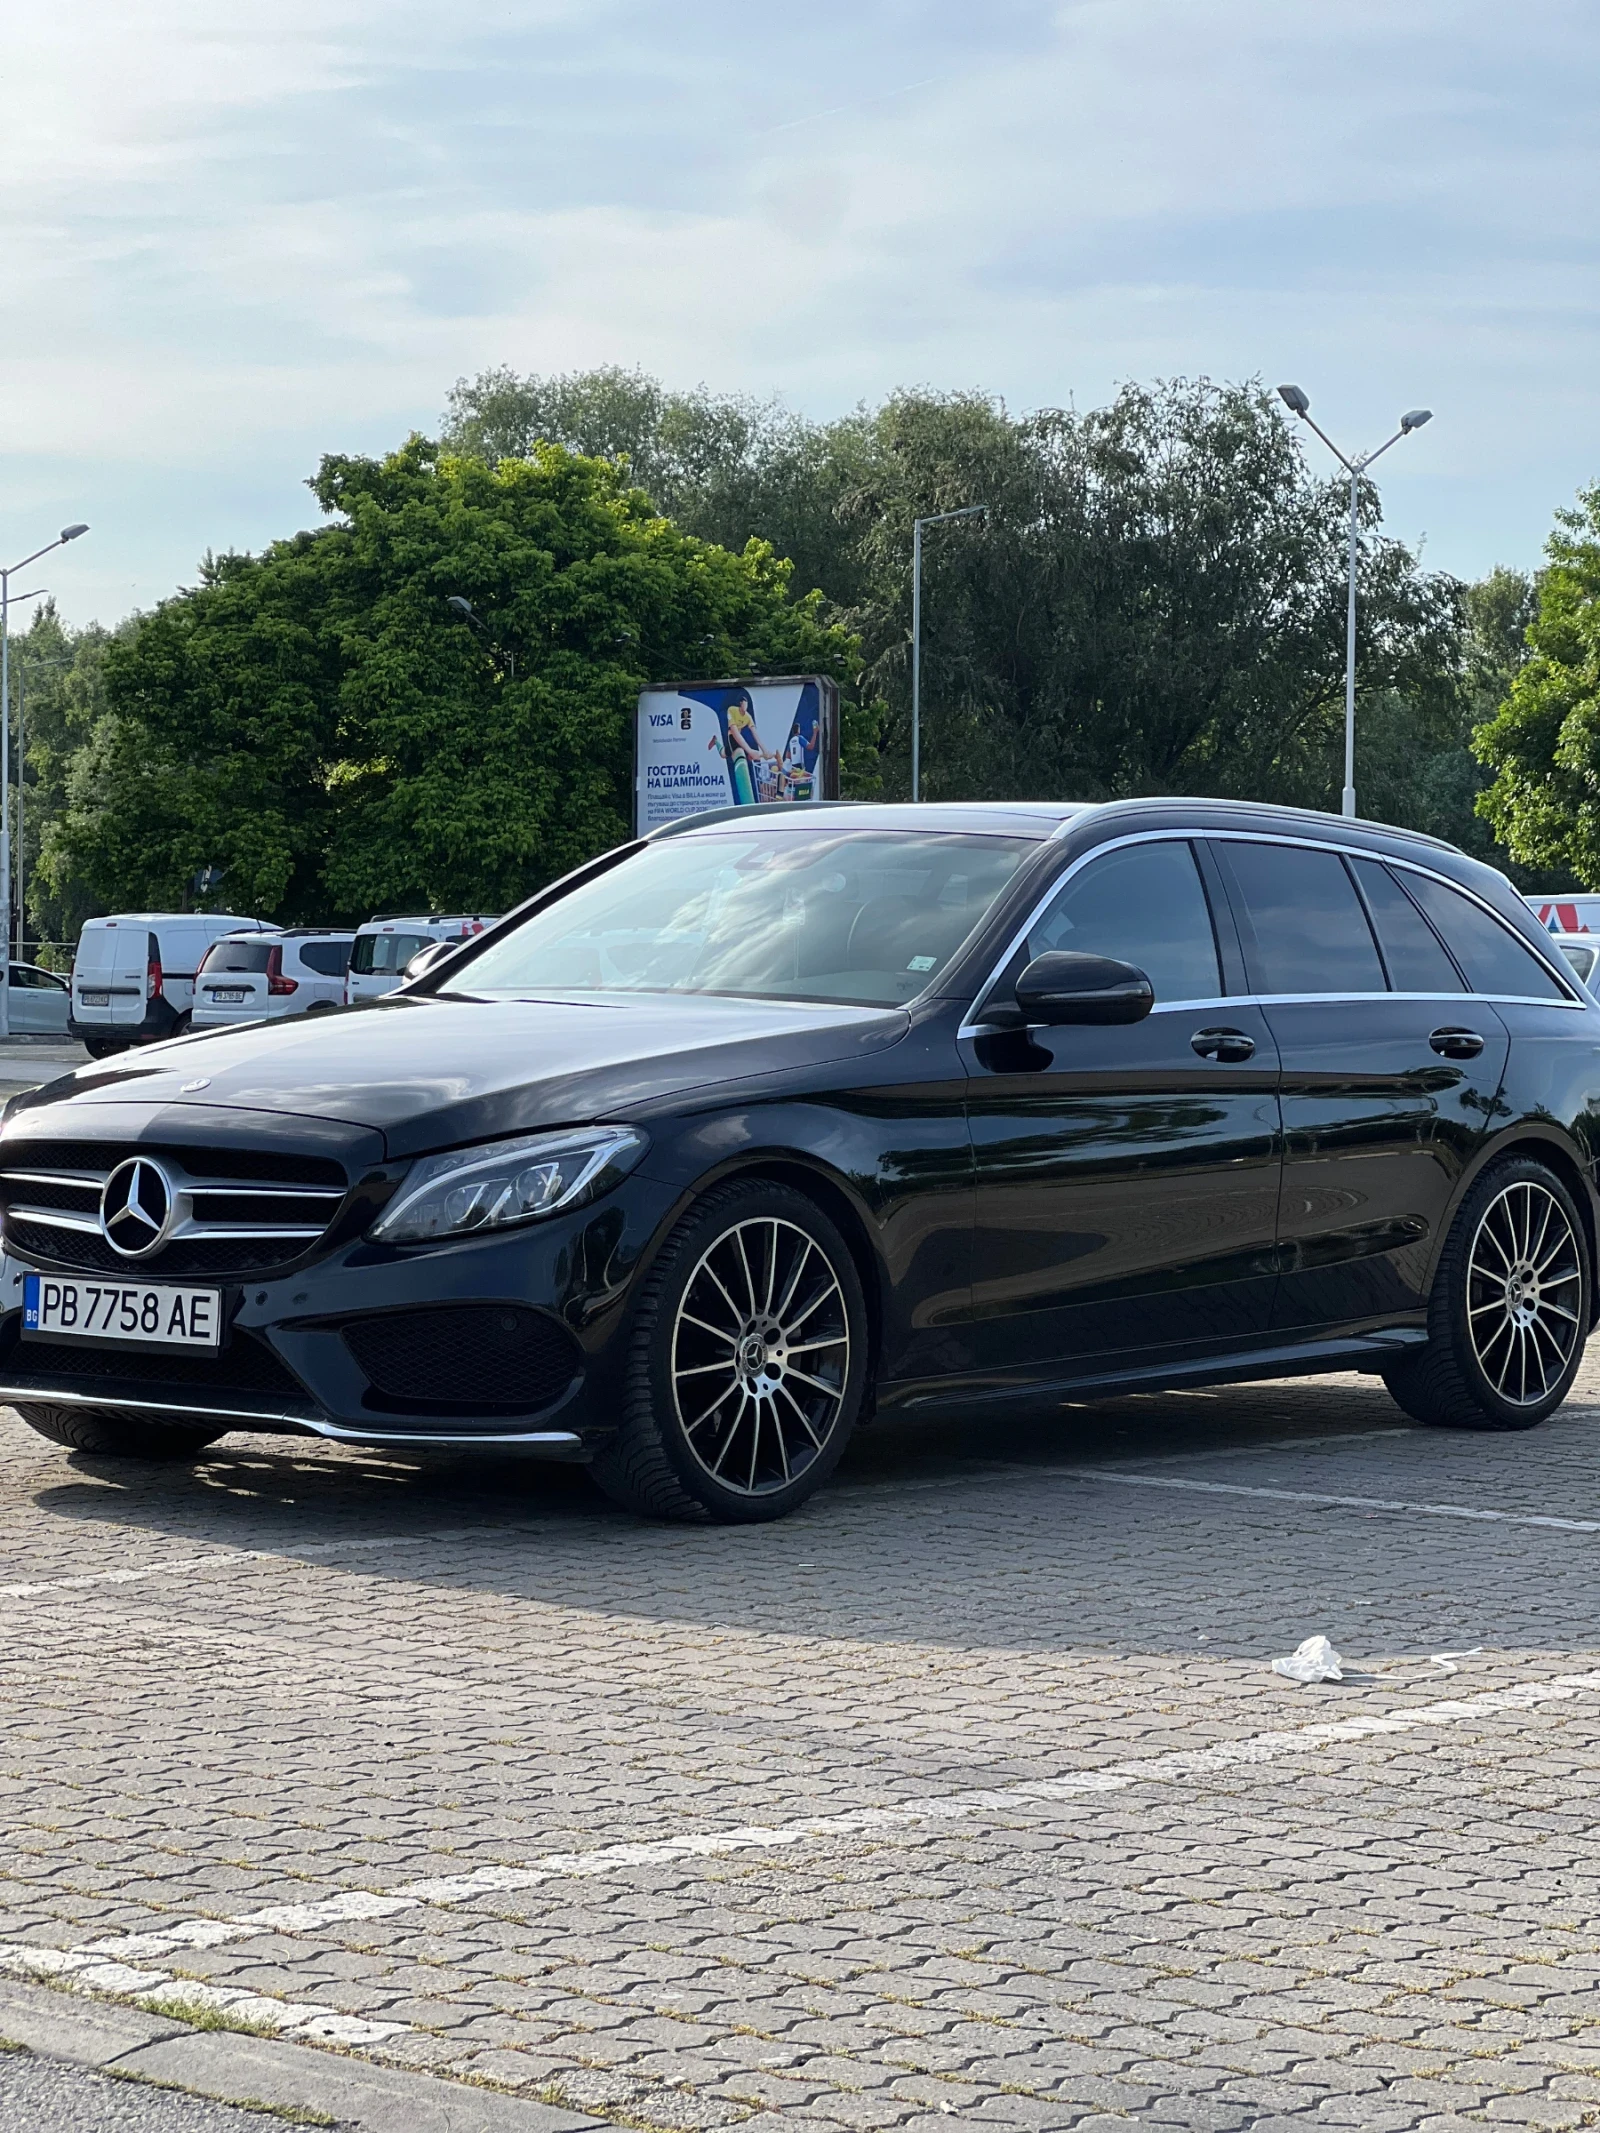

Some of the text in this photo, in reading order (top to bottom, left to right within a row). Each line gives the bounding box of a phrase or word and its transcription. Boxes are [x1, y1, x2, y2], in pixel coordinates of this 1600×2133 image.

[648, 714, 673, 727] VISA
[647, 762, 700, 776] ГОСТУВАЙ
[647, 775, 725, 788] НА ШАМПИОНА
[26, 1309, 38, 1322] BG
[42, 1283, 211, 1338] PB 7758 AE
